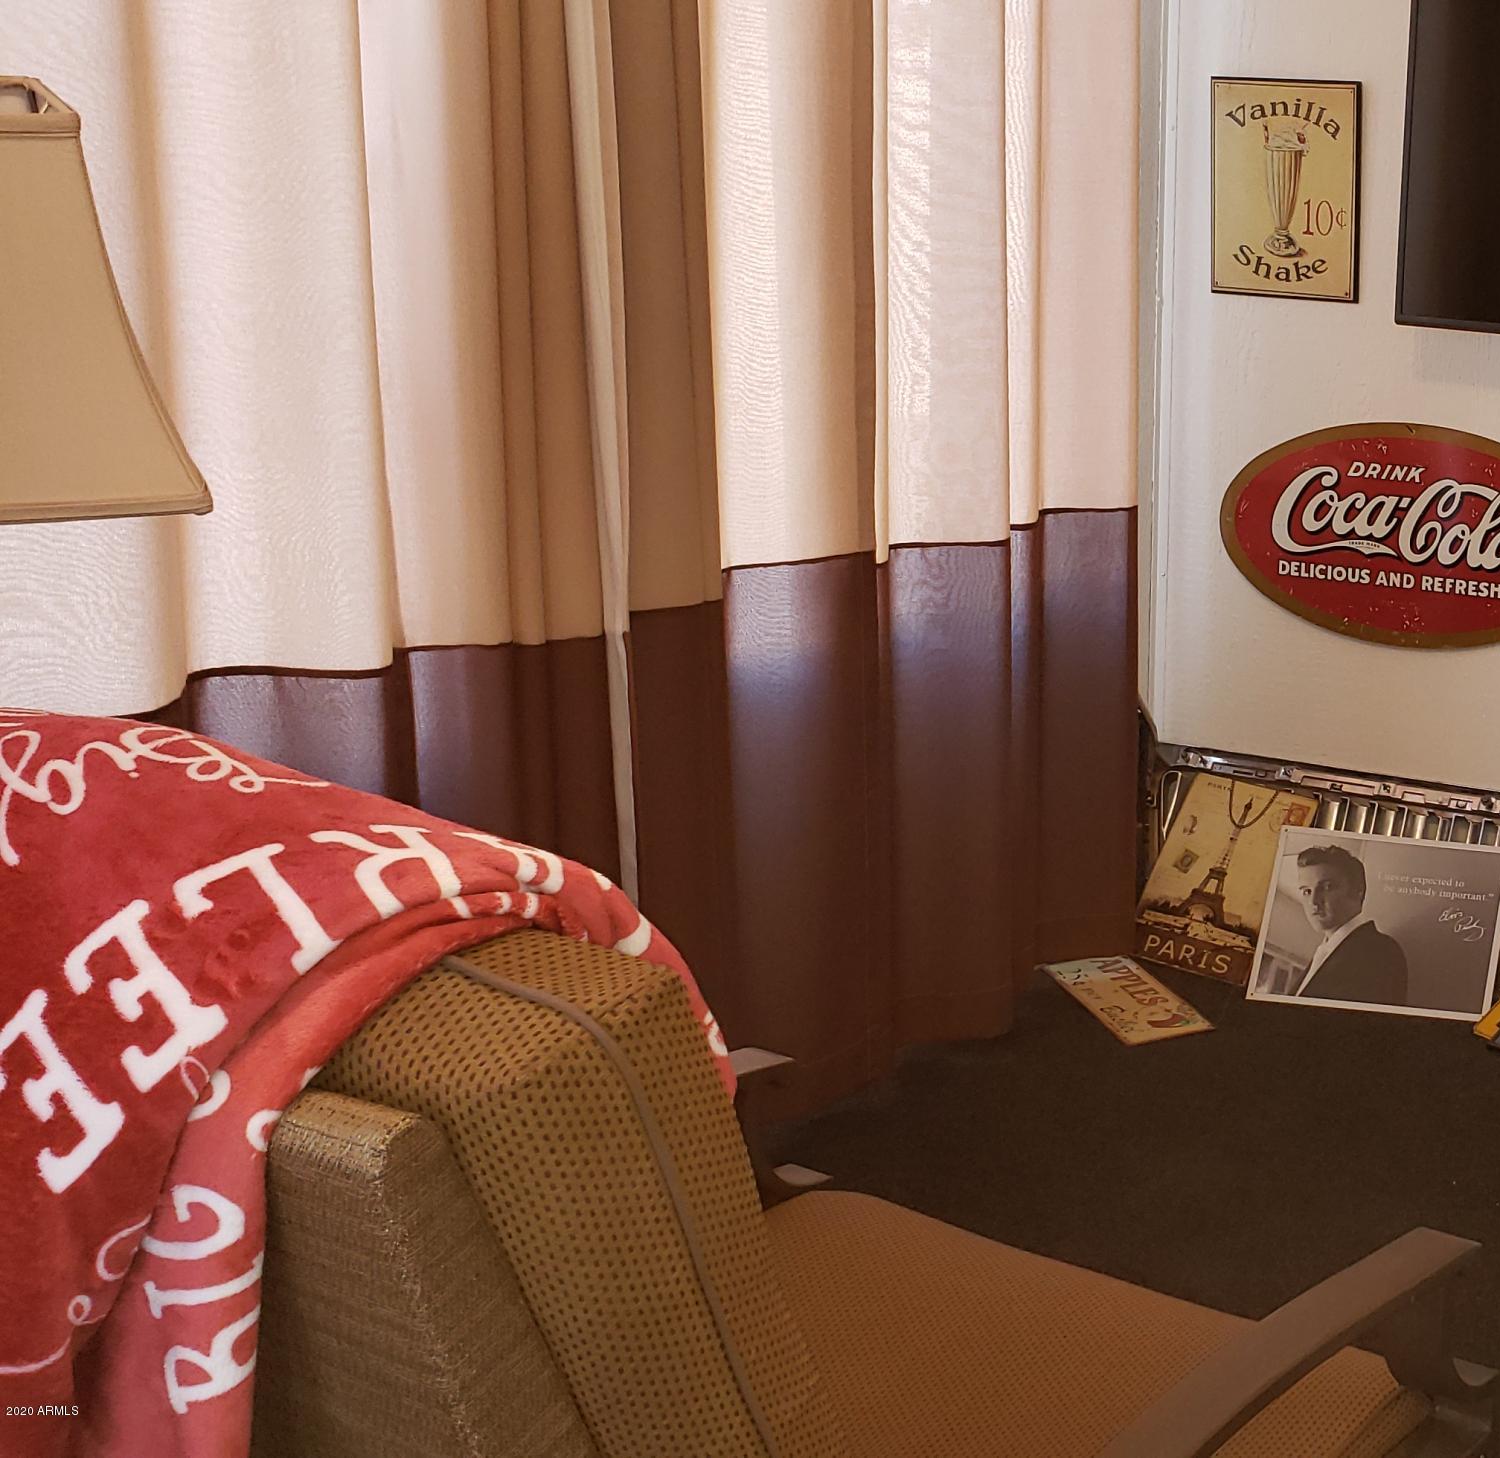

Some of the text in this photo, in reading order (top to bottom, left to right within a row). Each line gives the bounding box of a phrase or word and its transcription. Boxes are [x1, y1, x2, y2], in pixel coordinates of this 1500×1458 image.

[1226, 98, 1342, 140] Vanilla
[1302, 199, 1347, 236] 10¢
[1232, 244, 1328, 282] Shake
[1347, 462, 1427, 483] DRINK
[1278, 560, 1371, 585] DELICIOUS
[1375, 573, 1415, 590] AND
[1398, 887, 1436, 897] anybody
[1411, 875, 1453, 887] expected
[1455, 878, 1465, 887] to
[1143, 934, 1232, 975] PARIS
[1090, 957, 1168, 1006] APPLES
